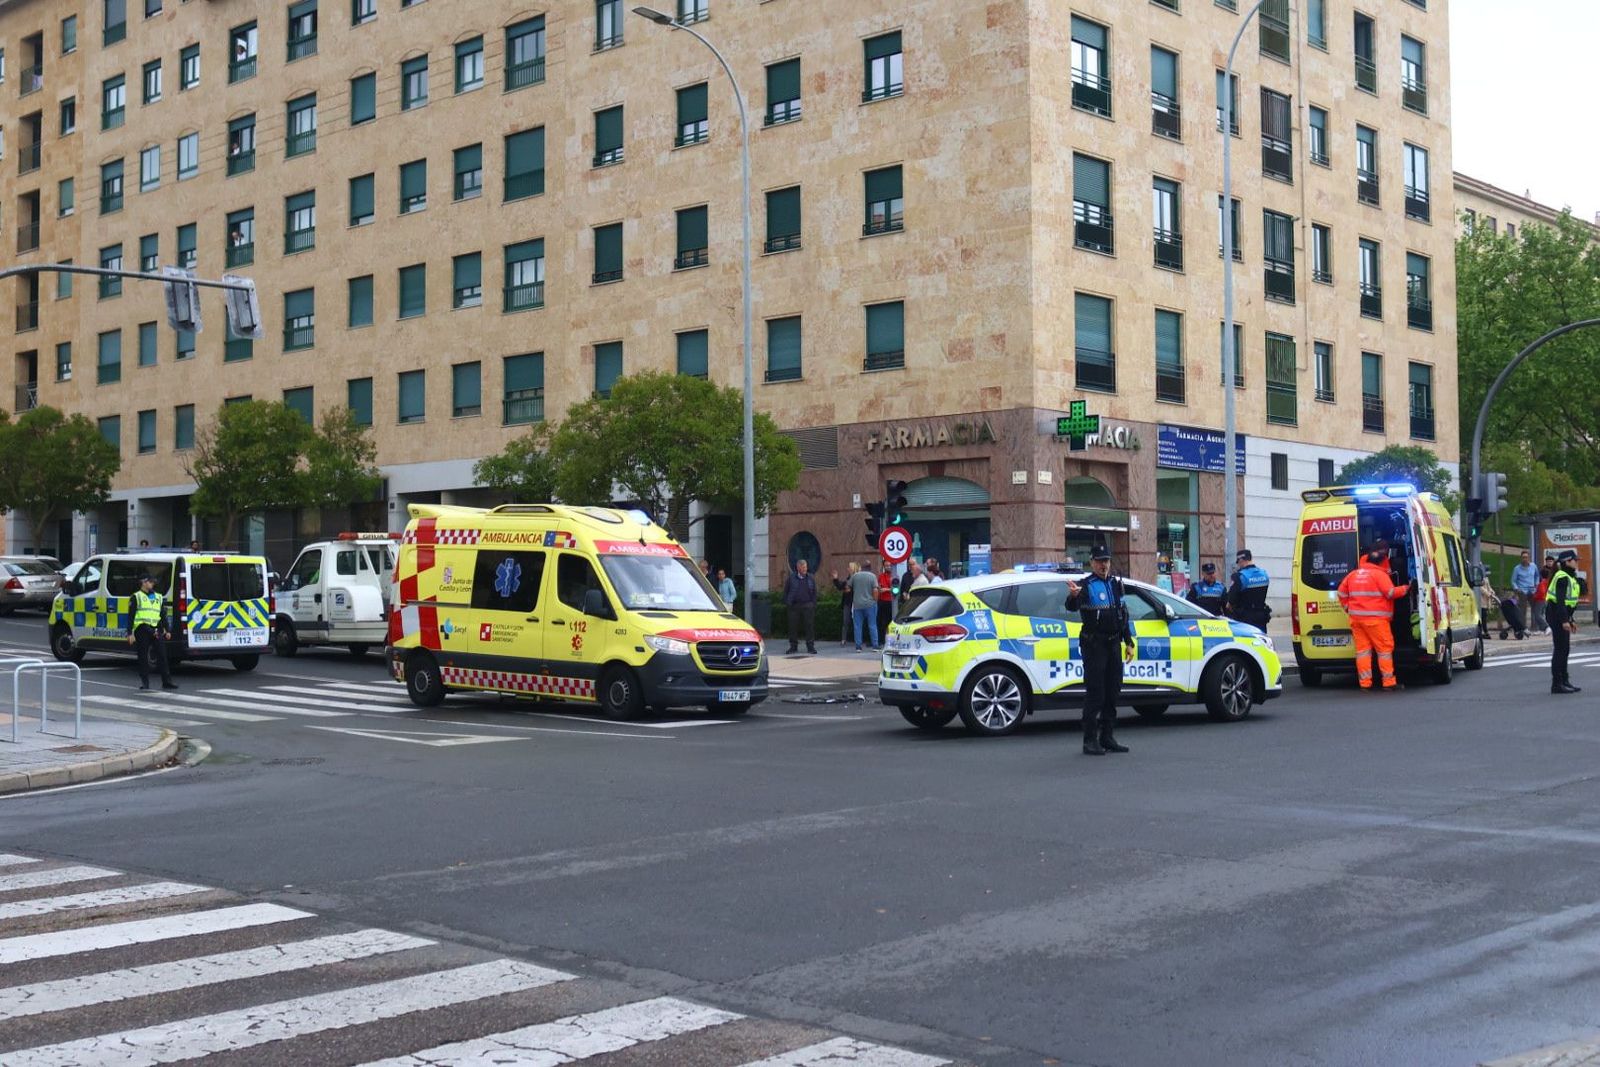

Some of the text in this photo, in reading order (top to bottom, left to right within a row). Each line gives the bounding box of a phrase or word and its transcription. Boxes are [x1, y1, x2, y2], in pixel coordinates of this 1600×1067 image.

[867, 421, 995, 451] FARMACIA
[1176, 429, 1204, 442] FARMACIA
[481, 532, 543, 544] AMBULANCIA
[887, 539, 905, 551] 30
[574, 620, 587, 632] 112
[1041, 623, 1063, 634] 112
[238, 636, 252, 644] 112
[1122, 661, 1159, 678] Local
